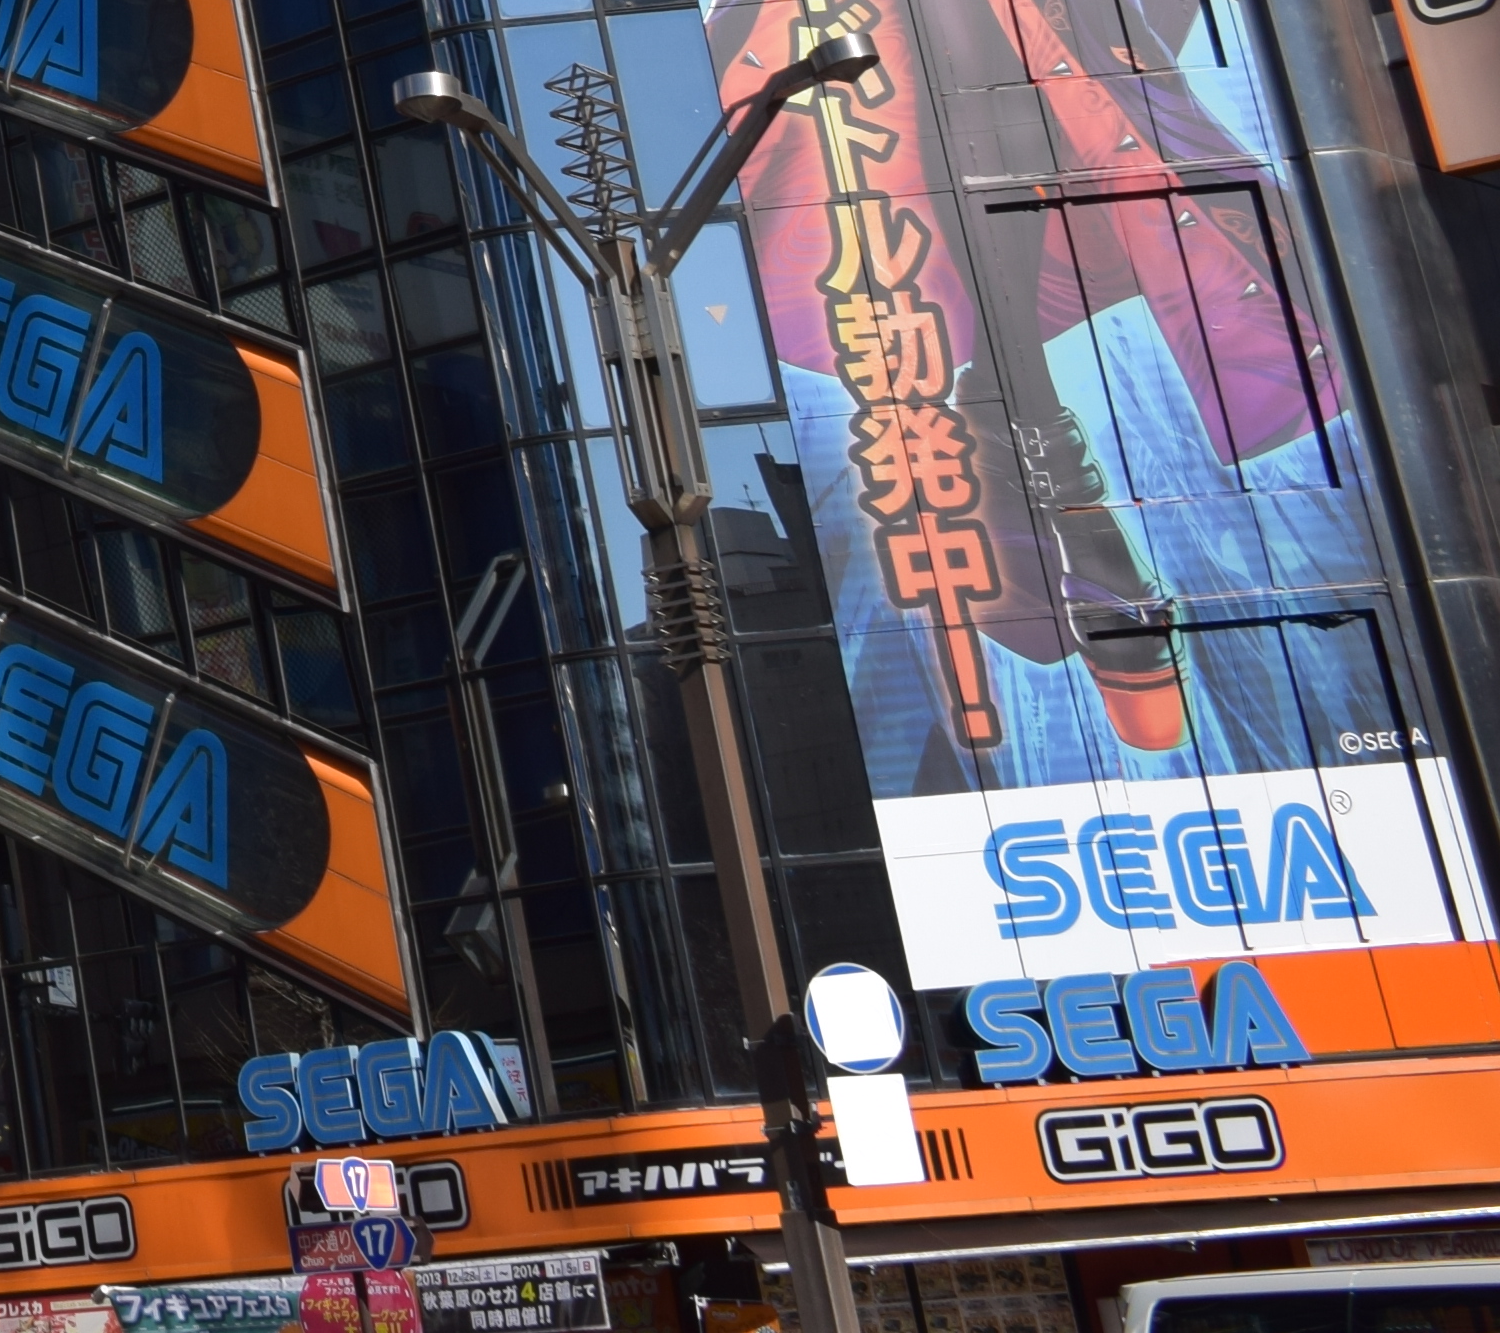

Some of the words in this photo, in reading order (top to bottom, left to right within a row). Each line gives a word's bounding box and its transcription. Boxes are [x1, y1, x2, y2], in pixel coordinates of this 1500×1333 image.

[983, 802, 1380, 941] SEGA
[965, 960, 1313, 1084] SEGA
[236, 1030, 509, 1154] SEGA
[1035, 1074, 1288, 1185] GiGO
[347, 1165, 366, 1200] 17
[576, 1155, 766, 1197] アキハバラ
[297, 1229, 352, 1254] 中央通り
[360, 1223, 388, 1259] 17
[414, 1271, 443, 1285] 2013
[117, 1291, 292, 1325] フィギュアフェスタ
[422, 1281, 597, 1311] 秋葉原のセガ4店舗にて
[469, 1305, 552, 1331] 同時開催!!
